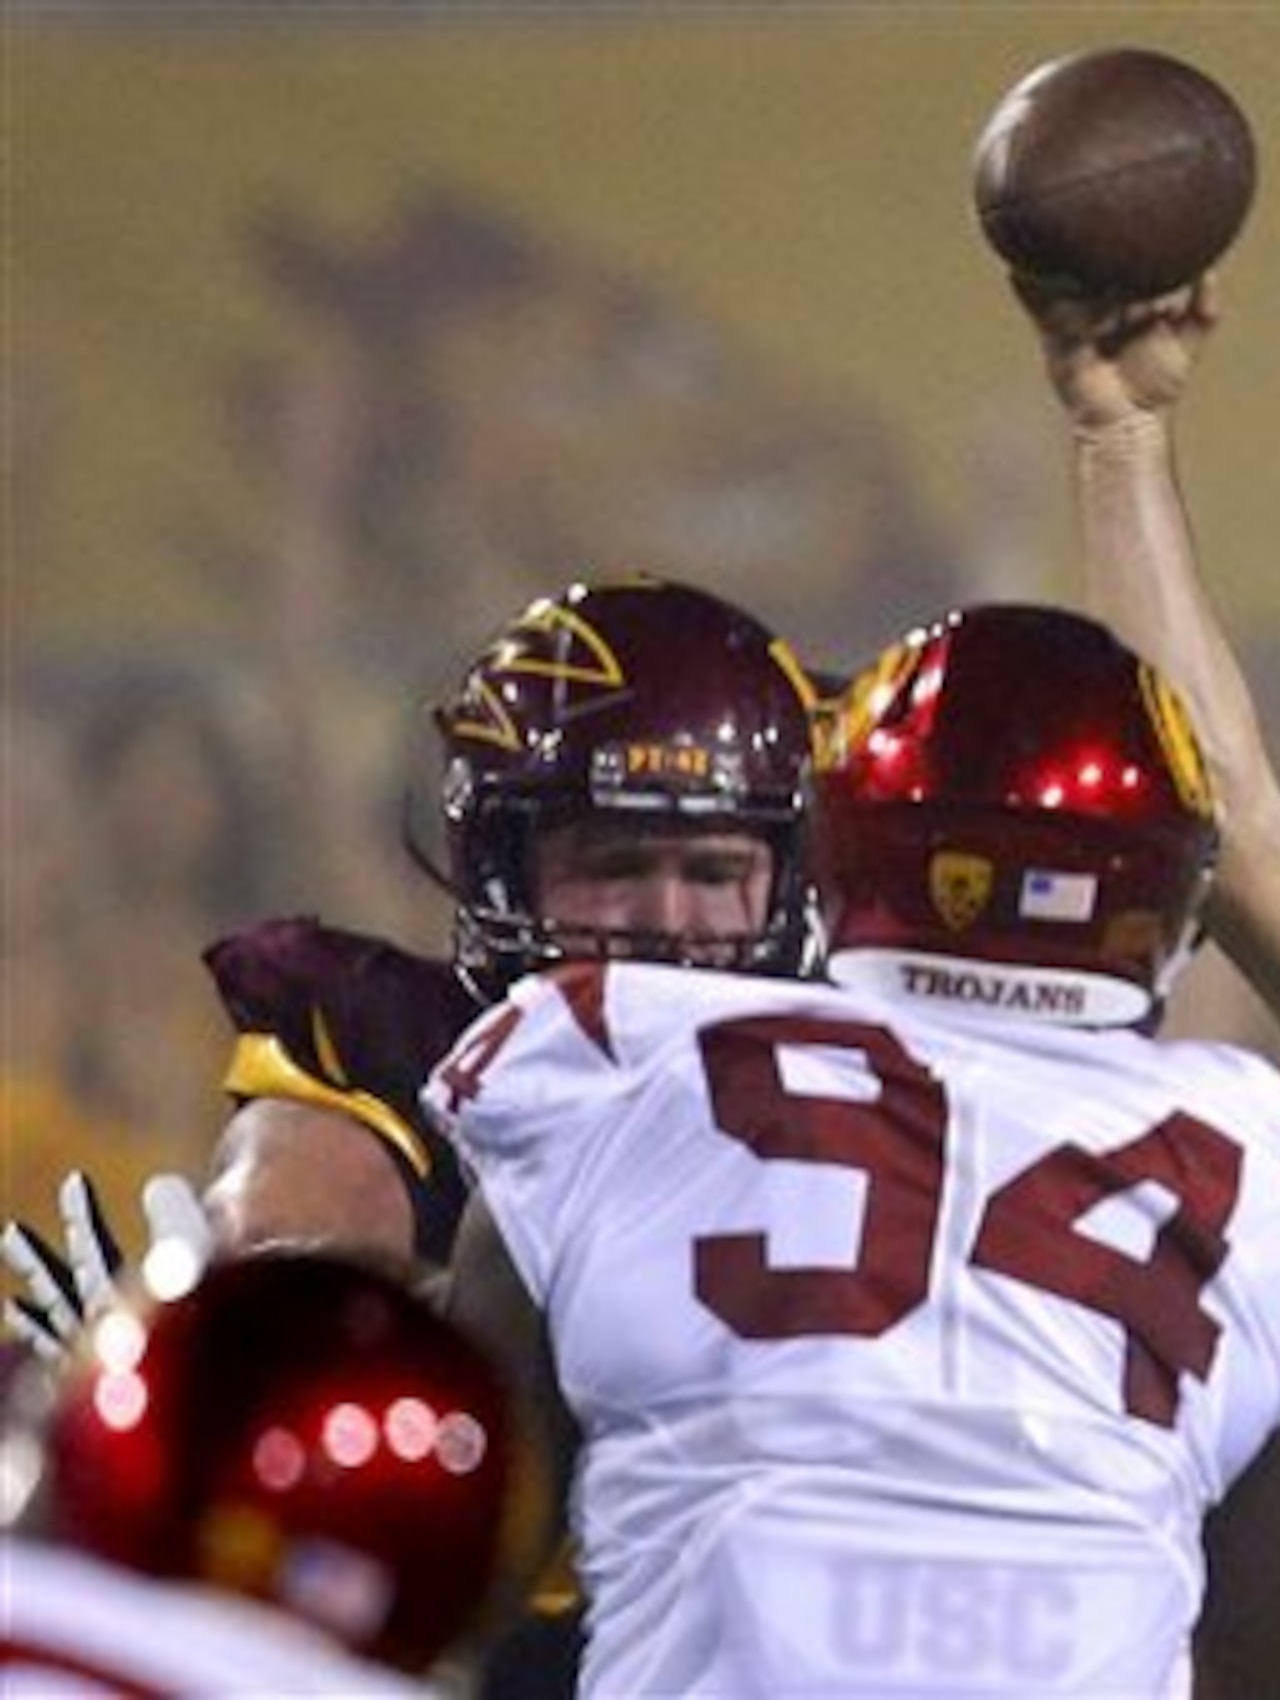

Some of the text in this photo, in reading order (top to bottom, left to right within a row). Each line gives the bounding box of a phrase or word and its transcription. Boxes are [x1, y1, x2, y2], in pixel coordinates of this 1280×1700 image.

[900, 962, 1087, 1015] TROJANS
[691, 1010, 1246, 1430] 94
[826, 1554, 1078, 1682] USC
